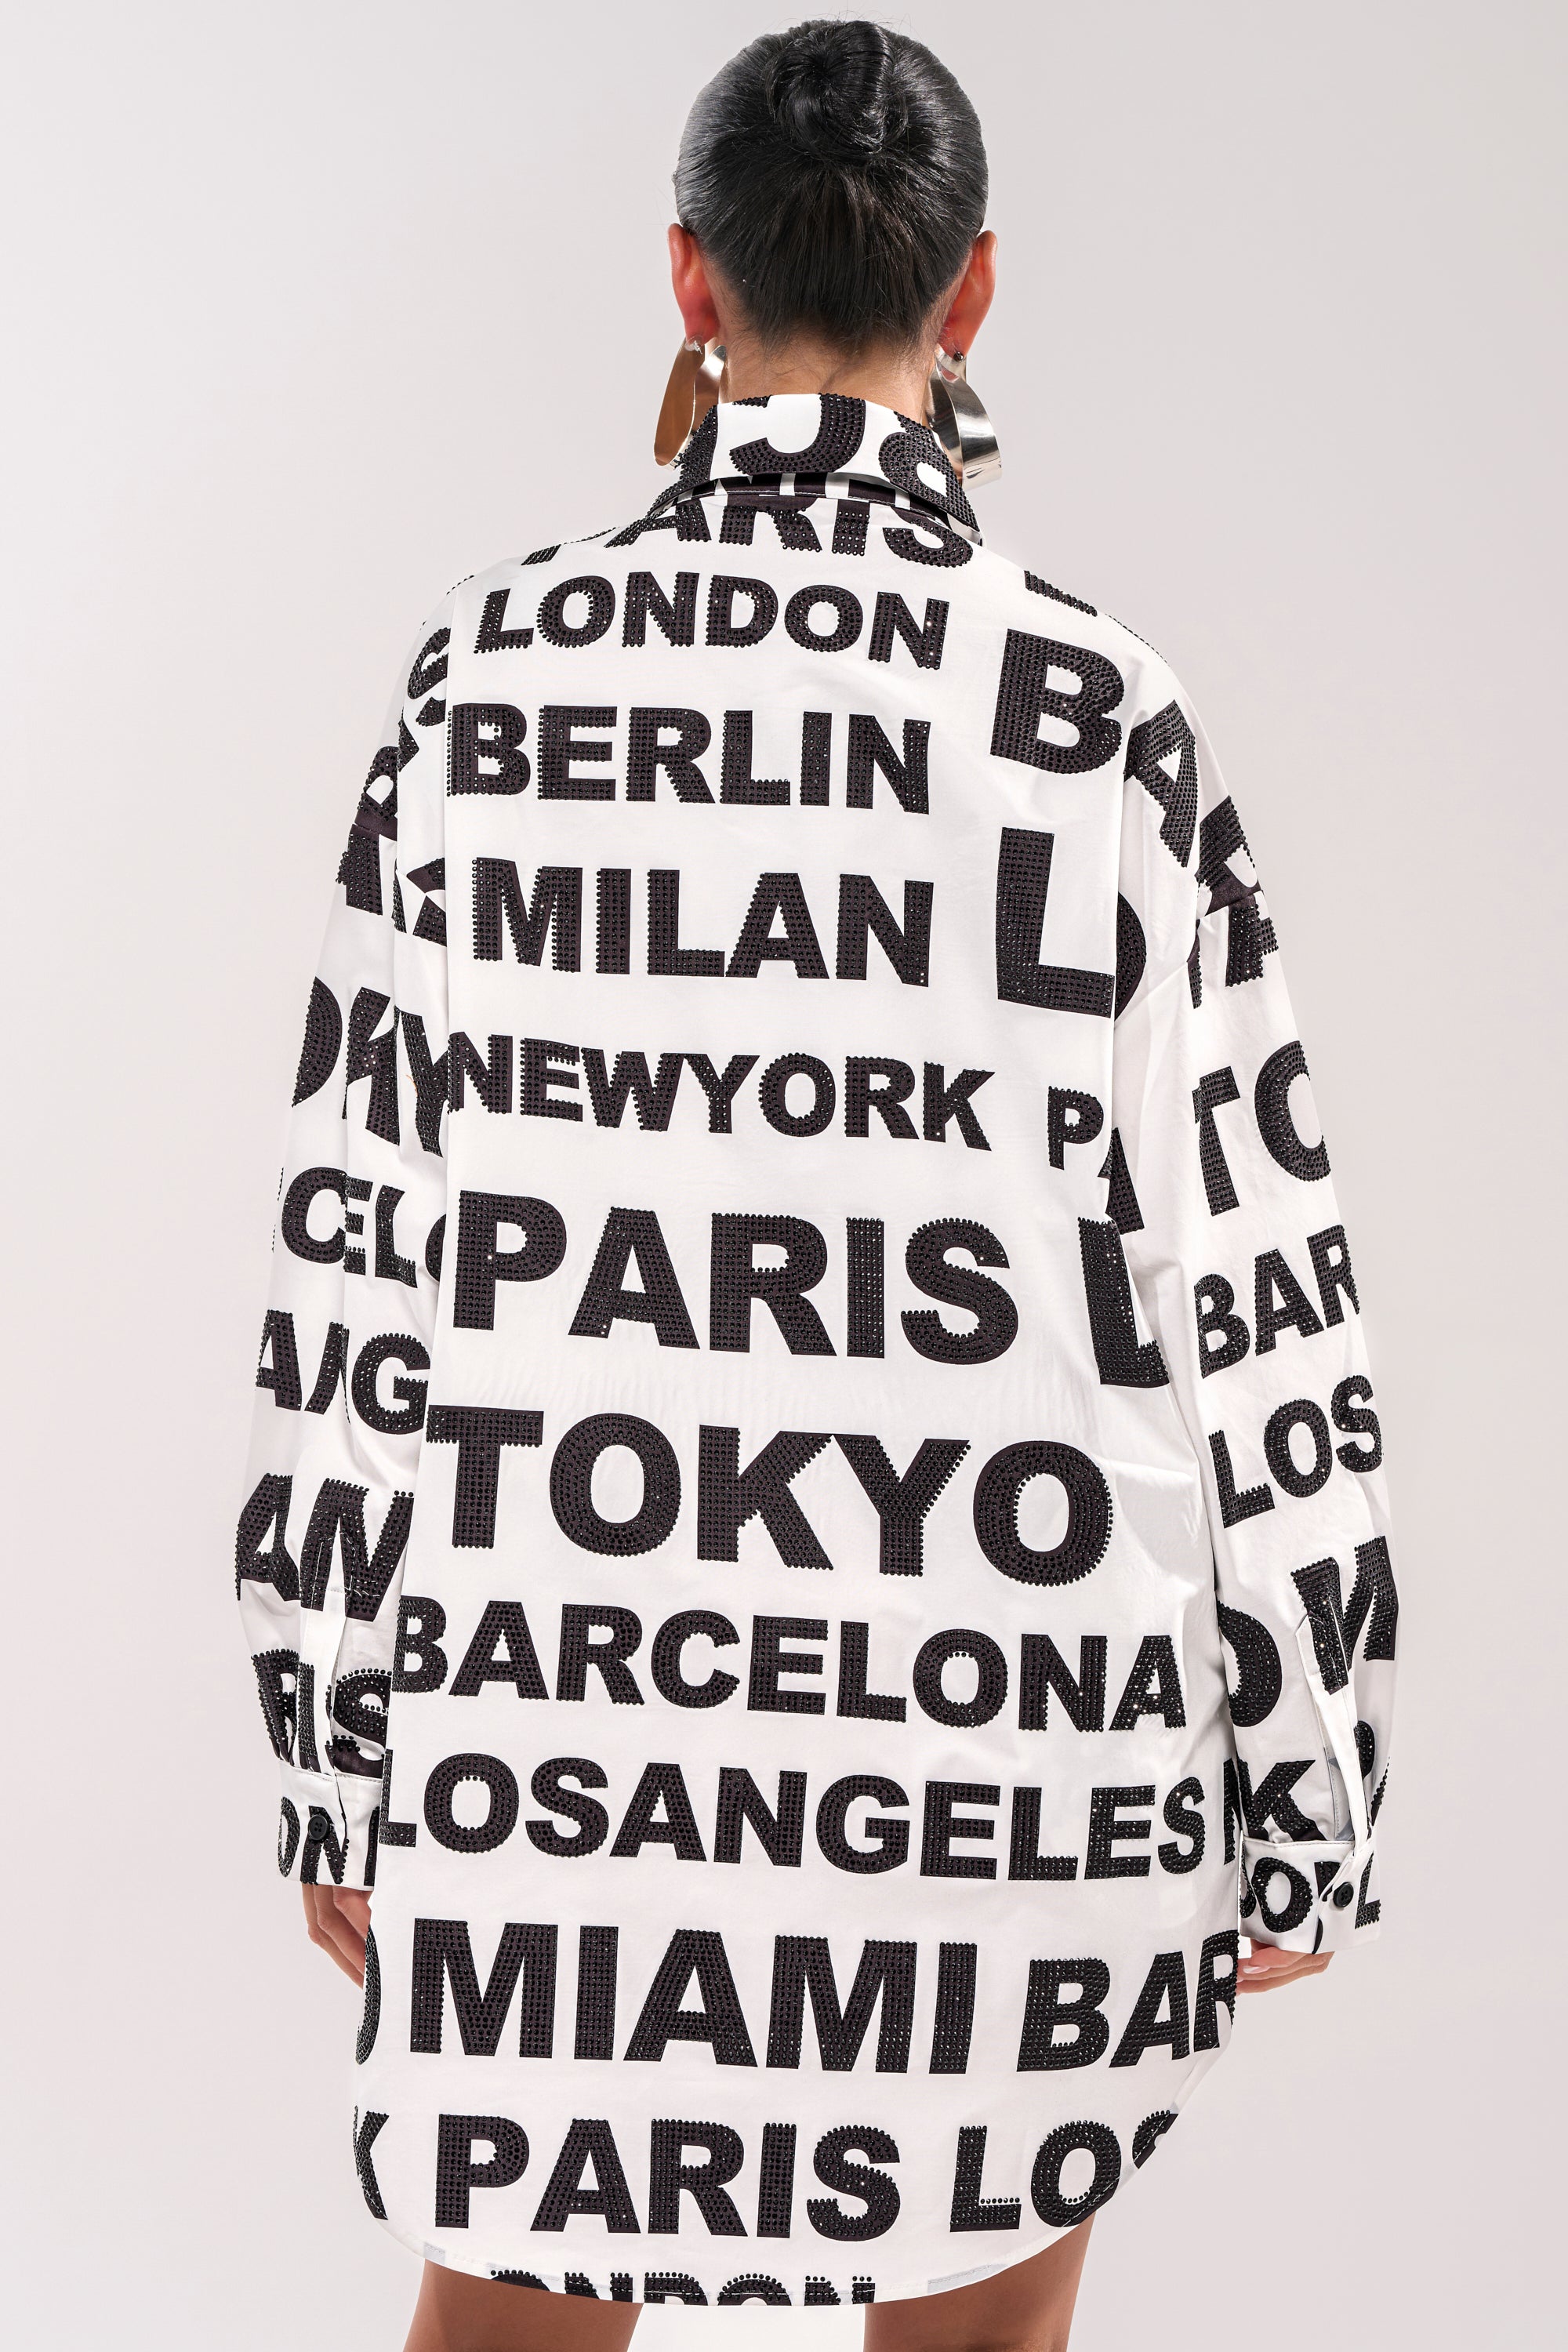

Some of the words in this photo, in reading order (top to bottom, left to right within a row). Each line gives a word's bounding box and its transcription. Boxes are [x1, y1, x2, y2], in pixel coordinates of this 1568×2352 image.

[474, 570, 950, 670] LONDON
[445, 701, 931, 815] BERLIN
[472, 857, 935, 988] MILAN
[447, 1029, 993, 1152] NEWYORK
[452, 1189, 1019, 1367] PARIS
[426, 1404, 1114, 1588] TOKYO
[392, 1594, 1187, 1733] BARCELONA
[378, 1748, 1207, 1882] LOSANGELES
[409, 1918, 978, 2075] MIAMI
[434, 2113, 902, 2243] PARIS
